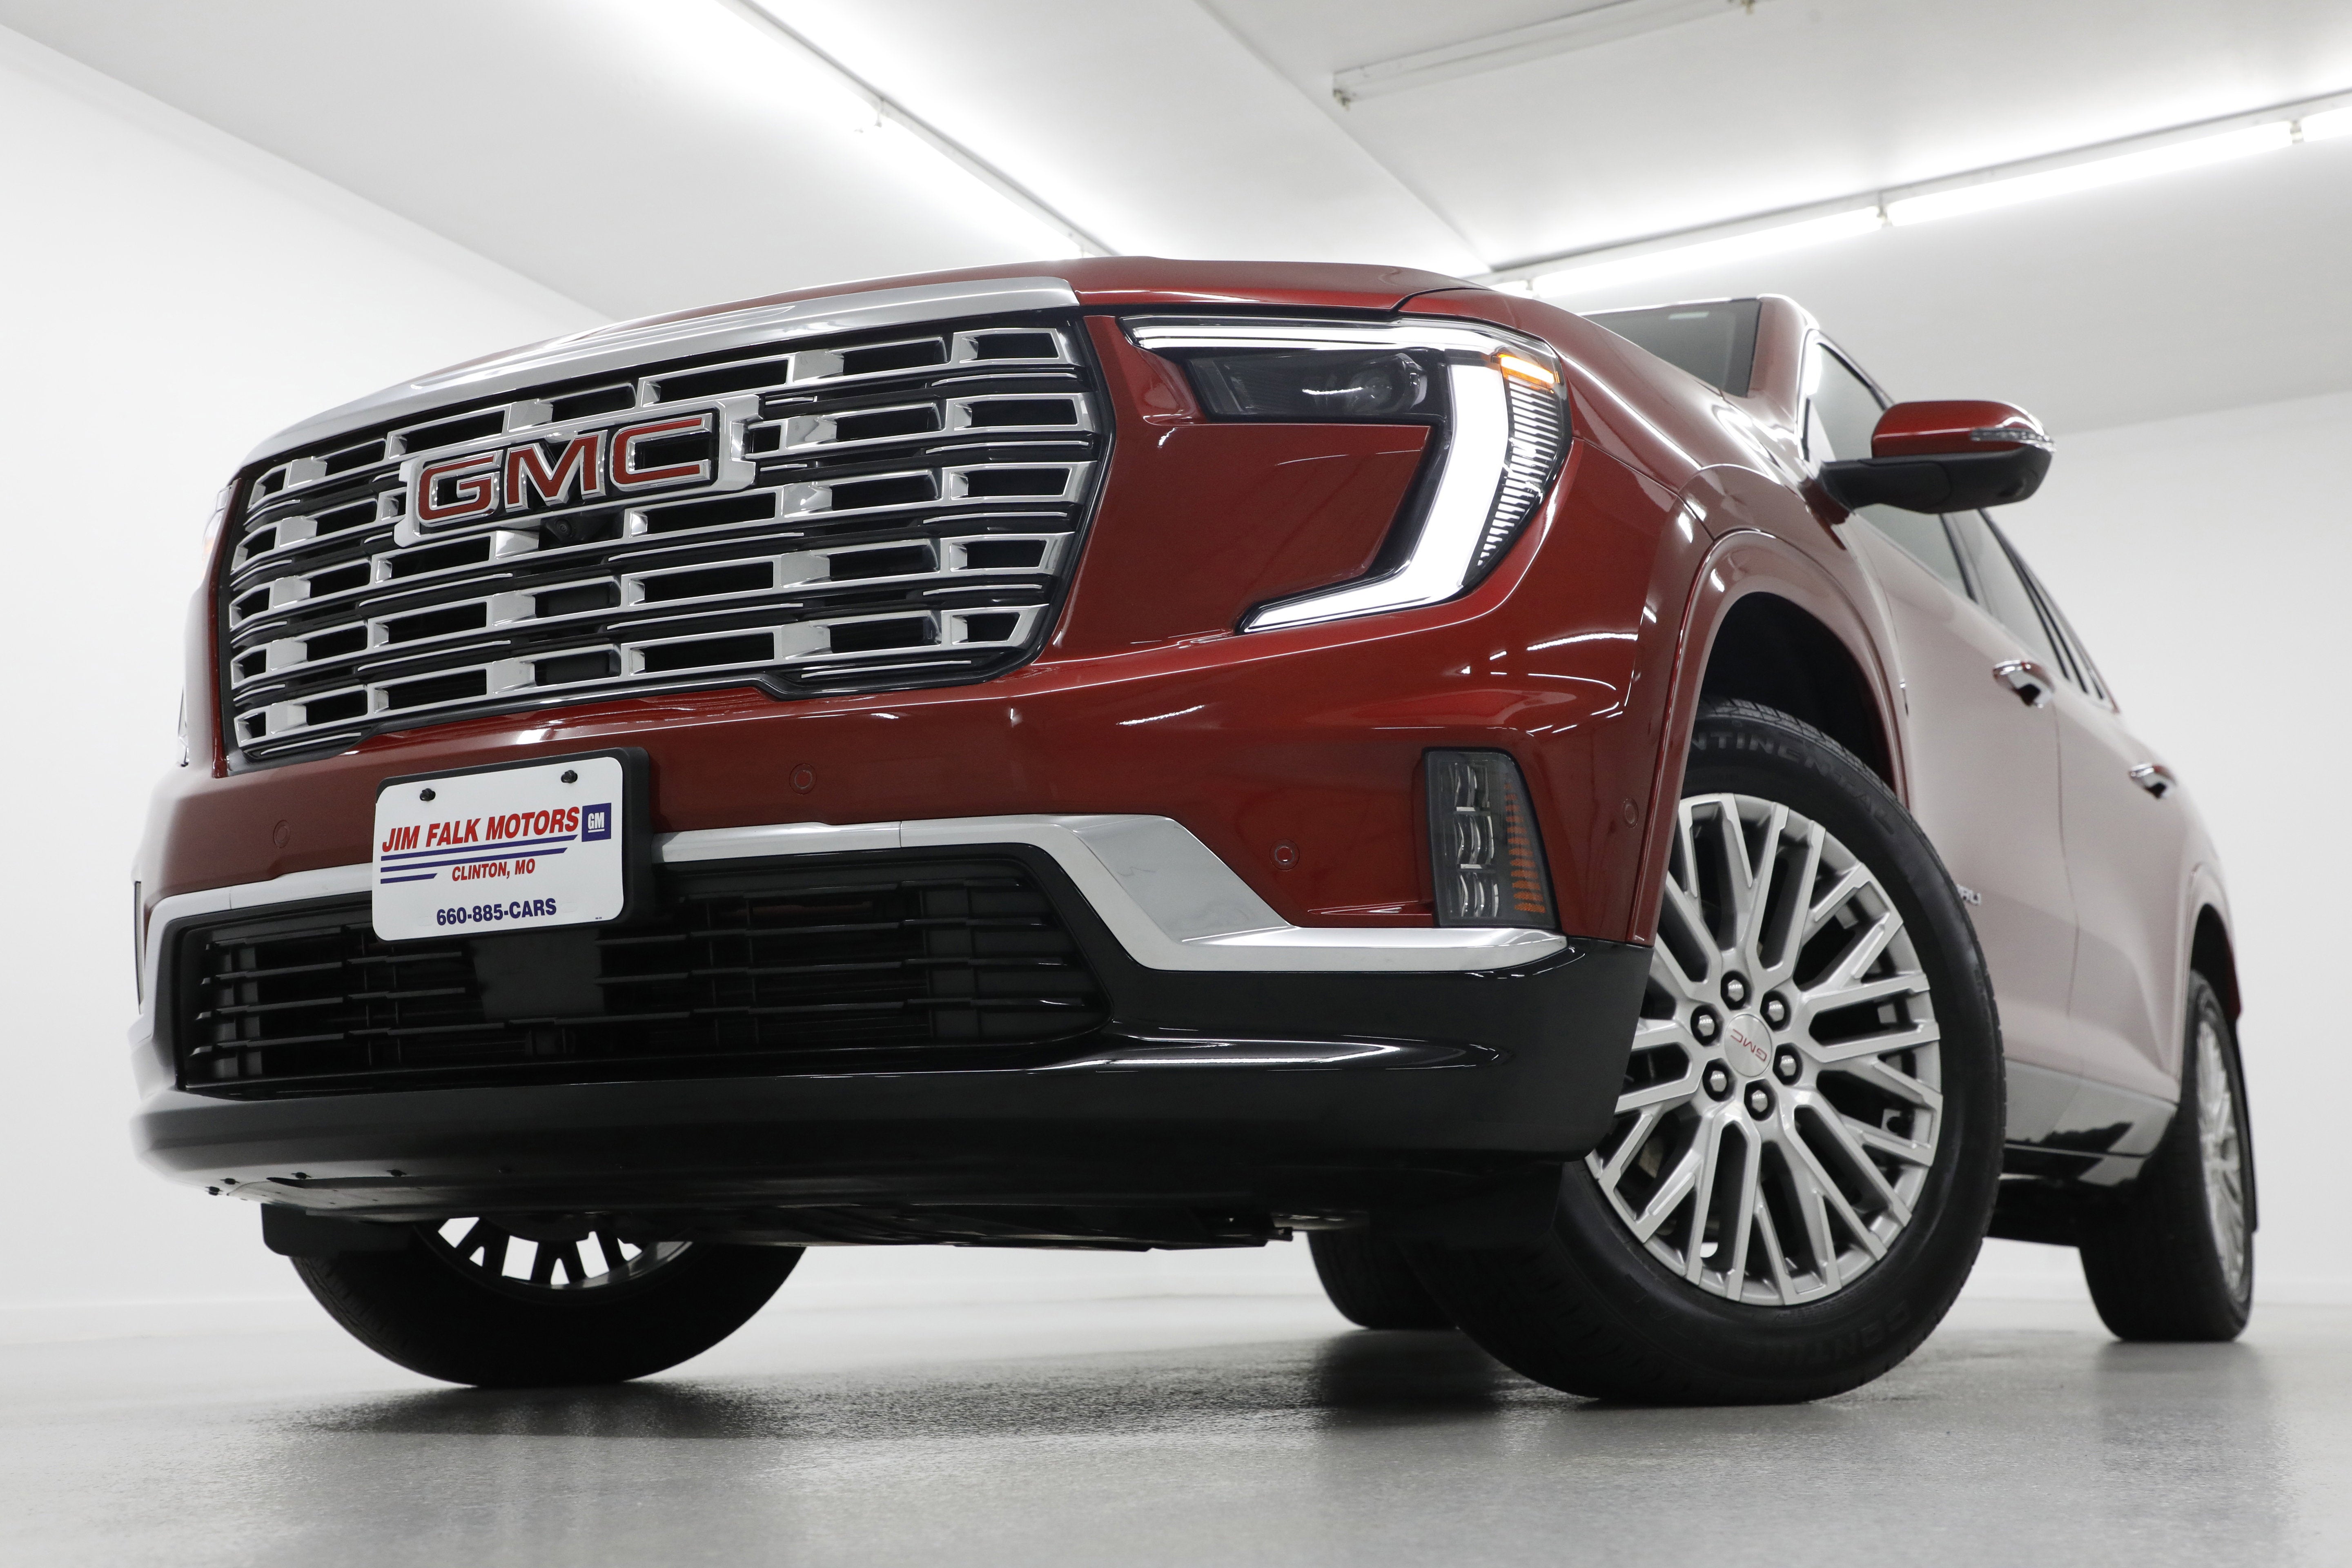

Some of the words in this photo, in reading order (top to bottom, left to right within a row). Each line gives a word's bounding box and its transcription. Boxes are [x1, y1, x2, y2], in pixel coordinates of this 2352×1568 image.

[418, 412, 713, 528] GMC
[382, 825, 421, 853] JIM
[425, 818, 481, 847] FALK
[486, 806, 580, 840] MOTORS
[588, 812, 605, 830] GM
[452, 861, 510, 882] CLINTON,
[515, 858, 535, 875] MO
[436, 898, 557, 926] 660-885-CARS
[1731, 1029, 1768, 1062] GMC
